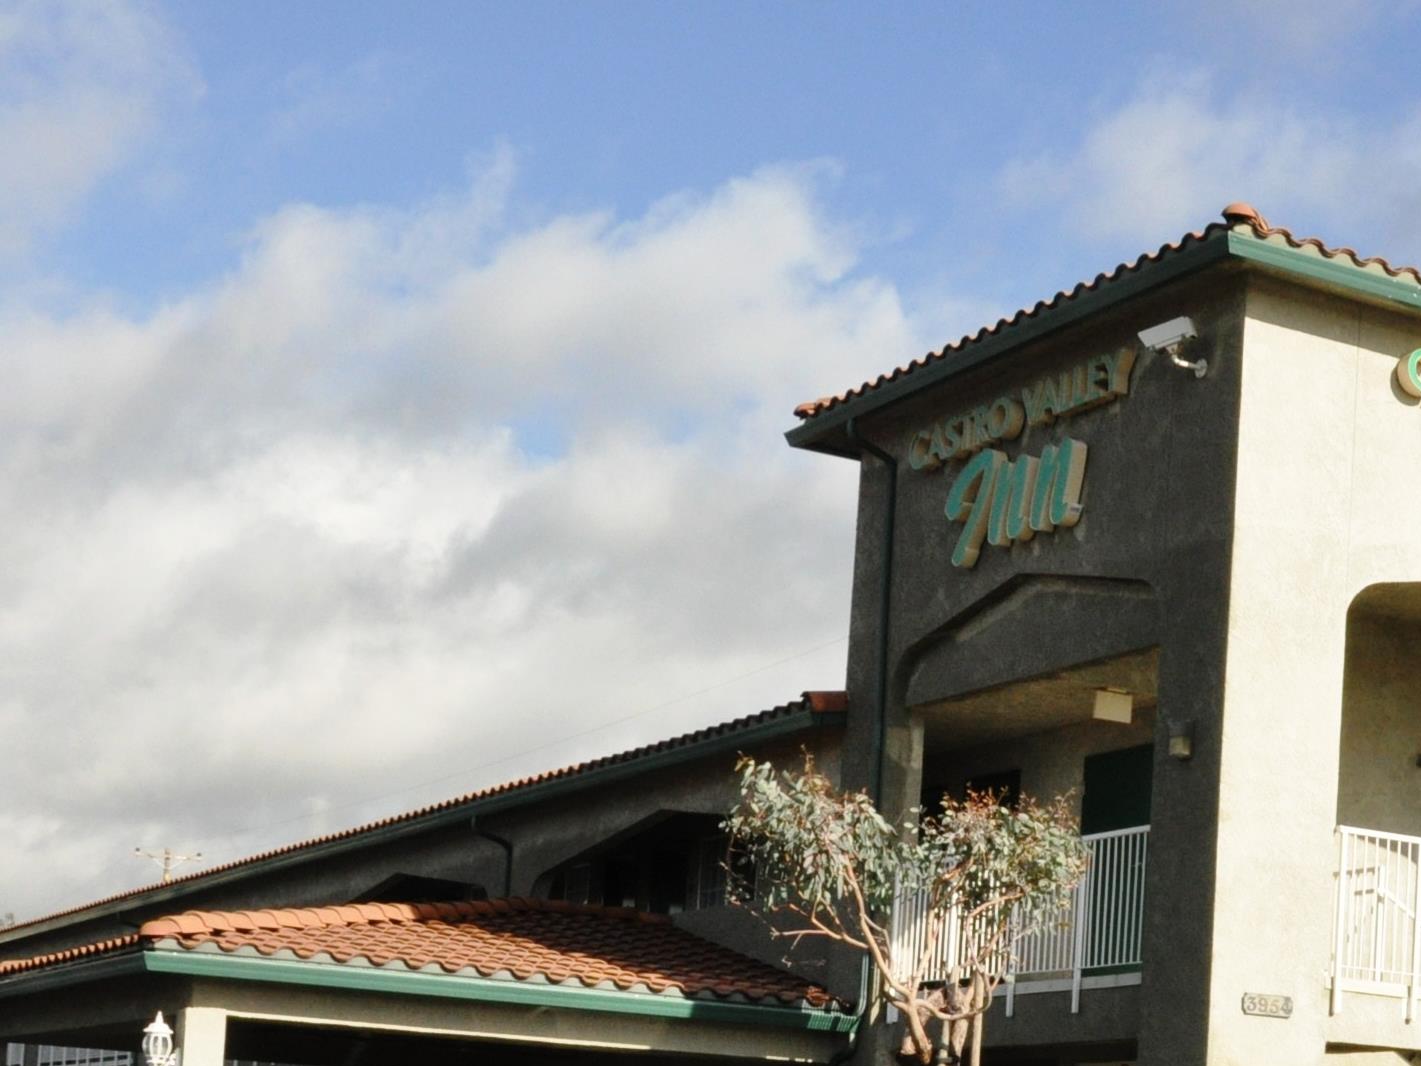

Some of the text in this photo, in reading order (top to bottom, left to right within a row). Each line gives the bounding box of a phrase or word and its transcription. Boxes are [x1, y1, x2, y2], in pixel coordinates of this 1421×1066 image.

[908, 349, 1136, 471] CASTRO VALLEY
[945, 437, 1087, 568] Inn
